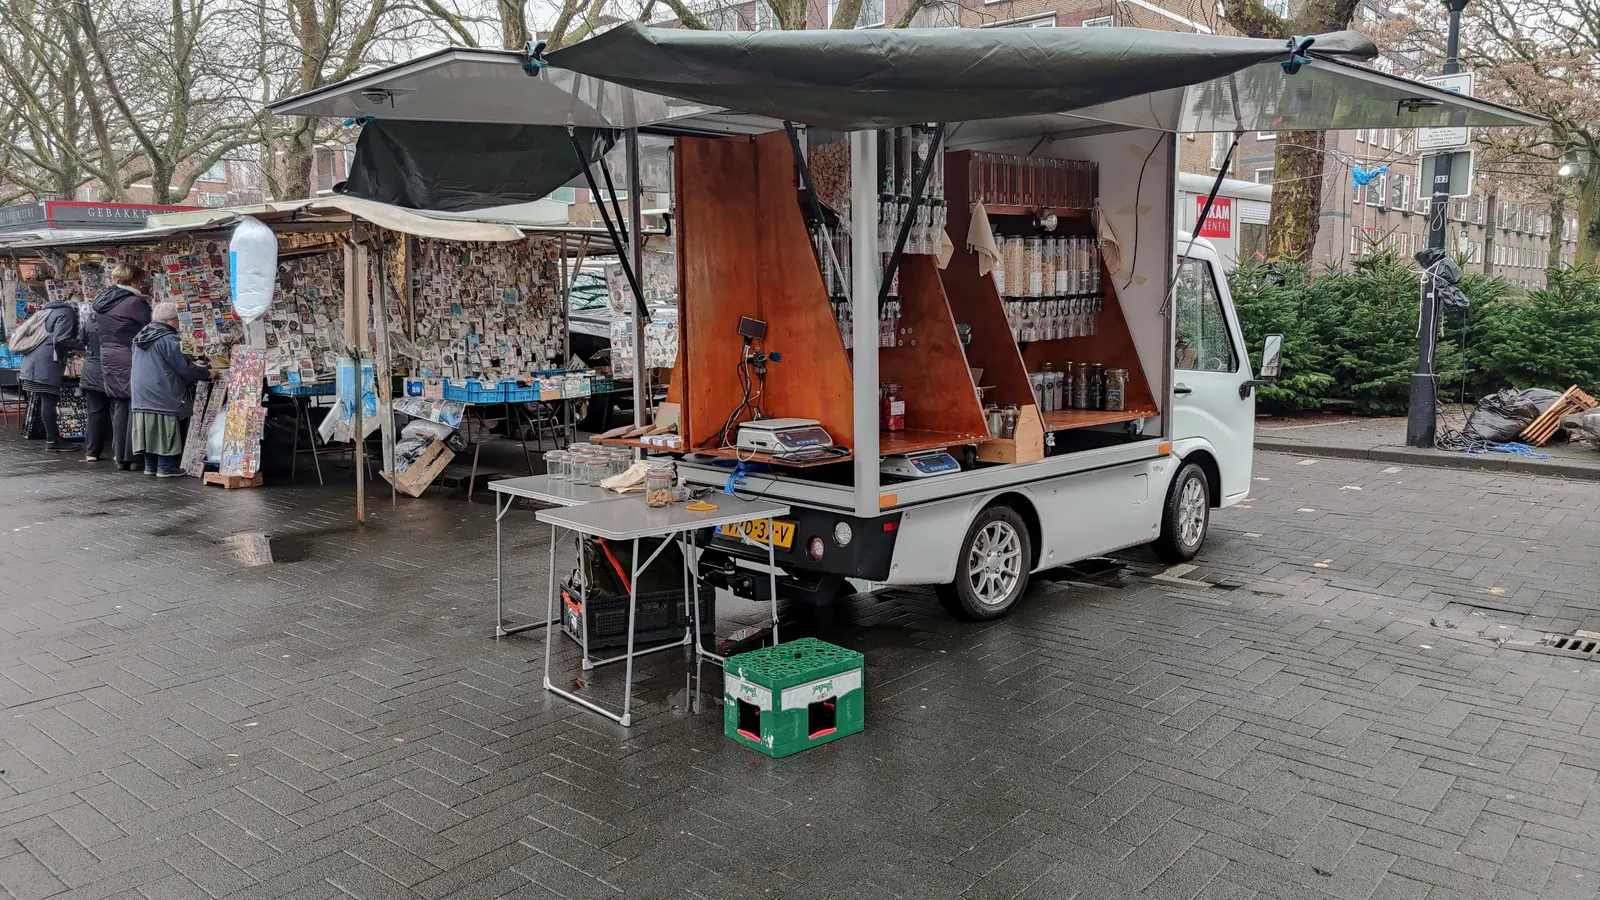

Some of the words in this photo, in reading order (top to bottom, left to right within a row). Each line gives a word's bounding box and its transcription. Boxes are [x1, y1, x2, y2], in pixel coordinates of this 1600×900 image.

[88, 207, 156, 219] GEBAKKEN
[1198, 203, 1230, 220] LXAM
[1203, 220, 1230, 232] RENTAL
